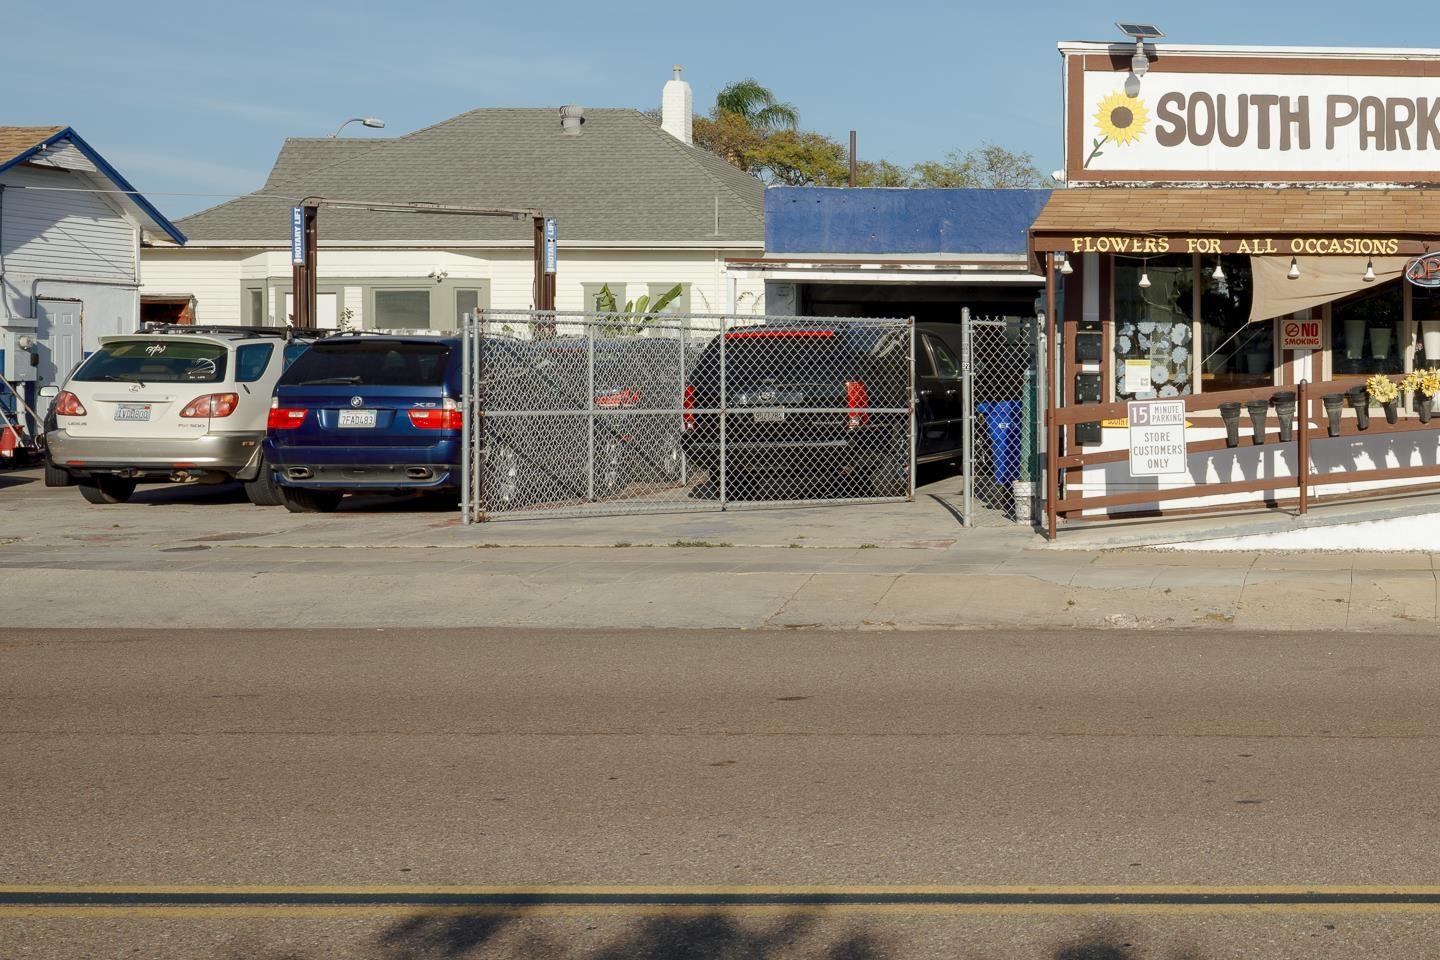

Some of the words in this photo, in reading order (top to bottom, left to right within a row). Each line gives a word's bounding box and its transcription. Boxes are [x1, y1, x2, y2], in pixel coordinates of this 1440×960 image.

[1155, 91, 1311, 151] SOUTH
[294, 226, 302, 258] ROTARY
[1072, 237, 1169, 253] FLOWERS
[1186, 238, 1221, 254] FOR
[1237, 238, 1277, 254] ALL
[1291, 238, 1399, 255] OCCASIONS
[1302, 322, 1318, 337] NO
[1285, 338, 1319, 346] SMOKING
[1132, 406, 1149, 424] 15
[1154, 405, 1180, 415] MINUTE
[342, 415, 374, 425] 7FAD483
[1152, 413, 1182, 423] PARKING
[1144, 431, 1171, 442] STORE
[1133, 445, 1182, 456] CUSTOMERS
[1147, 458, 1169, 469] ONLY
